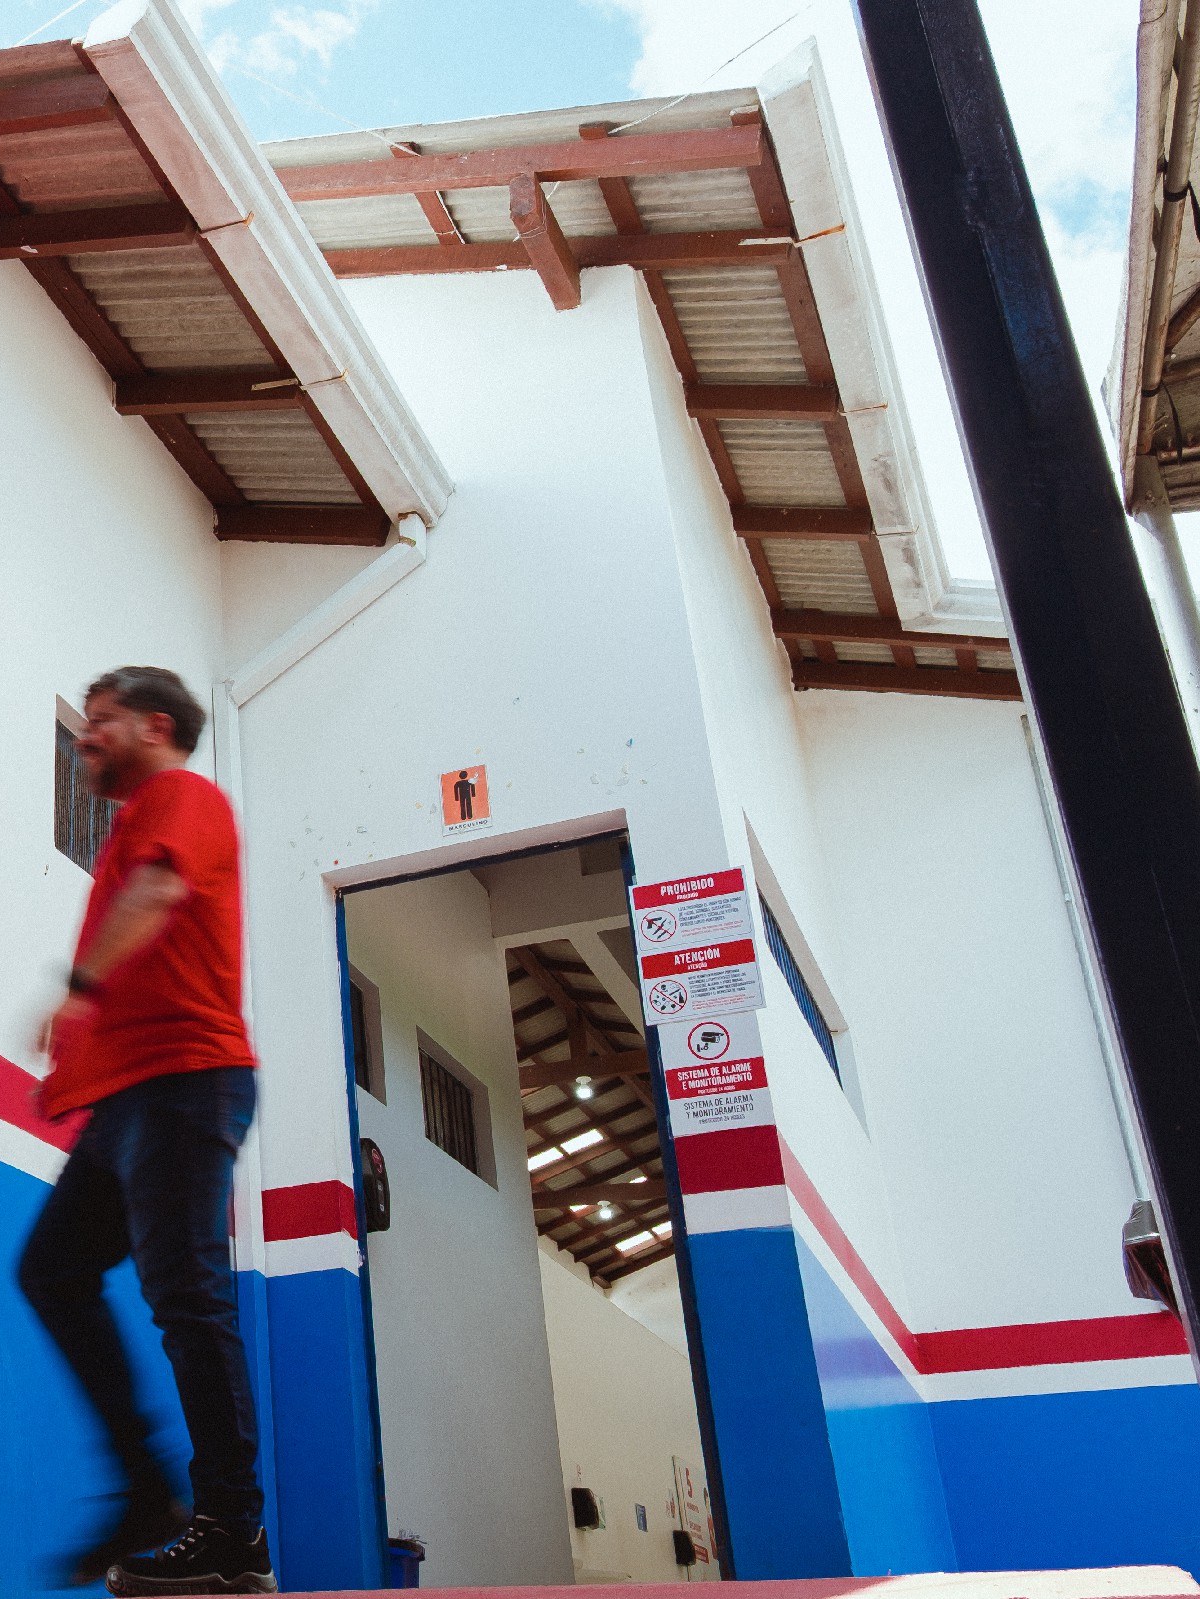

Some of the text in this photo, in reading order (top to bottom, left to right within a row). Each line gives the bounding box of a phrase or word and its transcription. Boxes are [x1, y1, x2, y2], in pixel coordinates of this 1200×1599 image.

[448, 819, 488, 831] MASCULINO
[660, 877, 715, 897] PROHIBIDO
[674, 947, 721, 966] ATENCIÓN
[677, 1062, 752, 1081] SISTEMA DE ALARME
[682, 1072, 753, 1090] E MONITORAMENTO
[683, 1094, 754, 1111] SISTEMA DE ALARMA
[692, 1103, 754, 1119] MONITORAMIENTO
